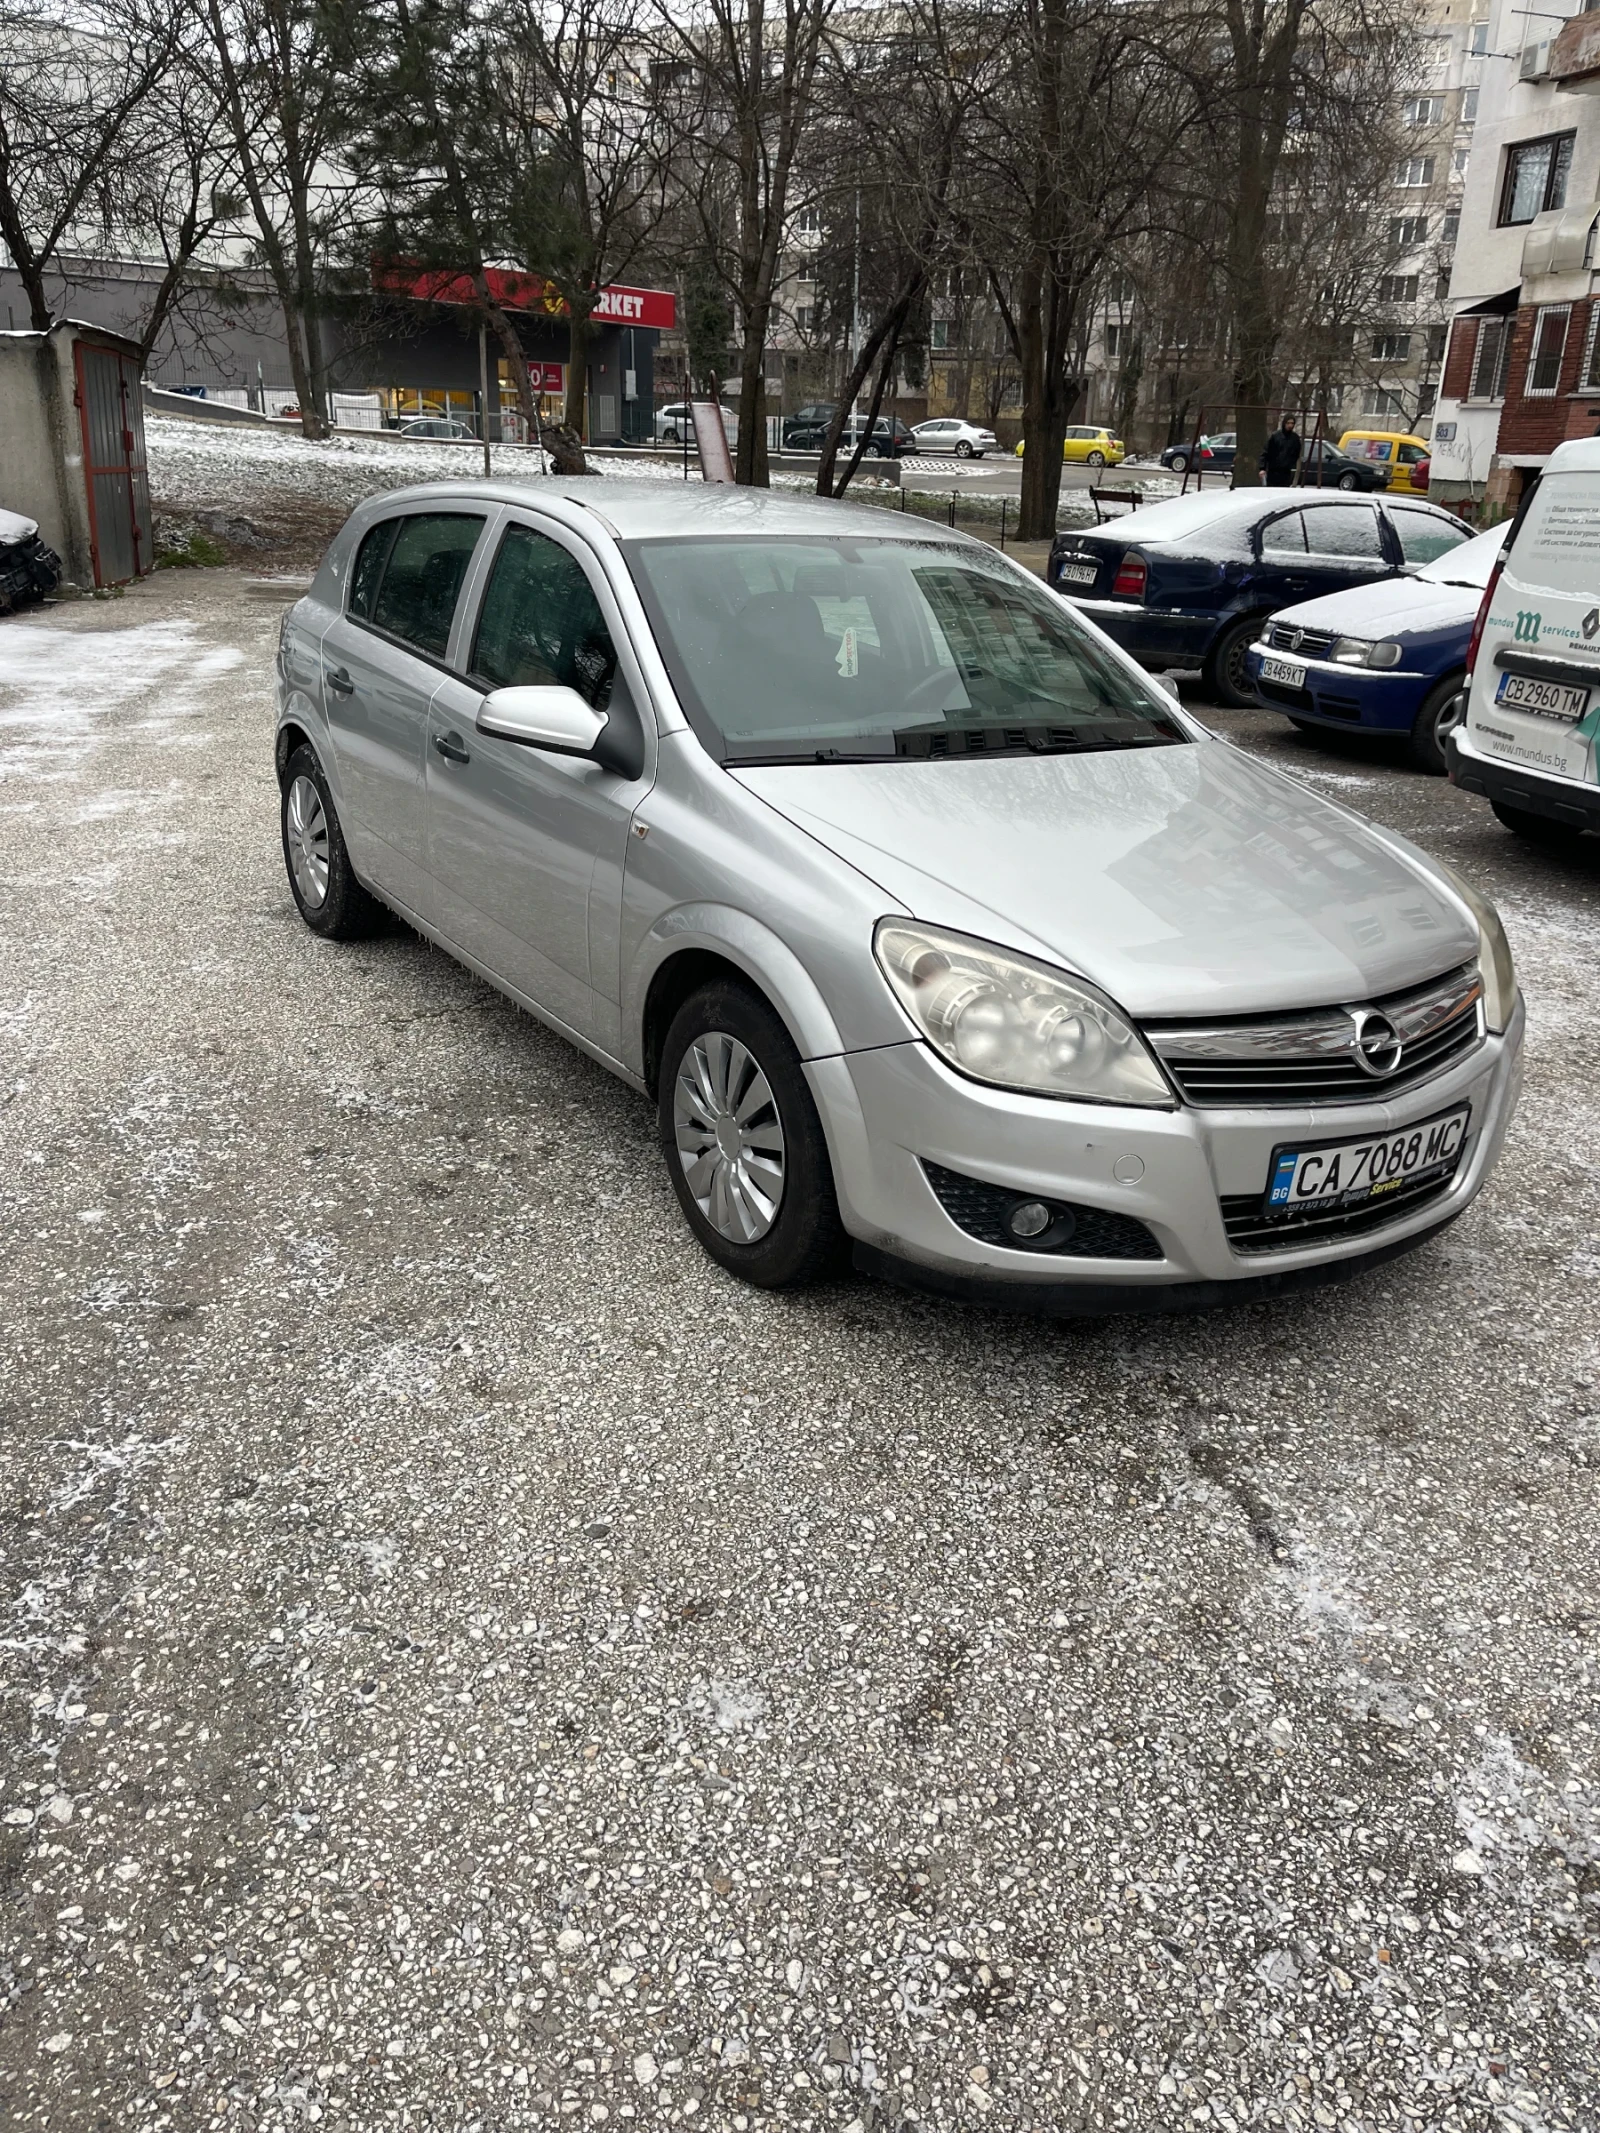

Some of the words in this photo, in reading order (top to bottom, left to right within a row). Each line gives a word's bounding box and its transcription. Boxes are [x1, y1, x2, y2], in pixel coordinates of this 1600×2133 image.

[593, 291, 644, 319] RKET
[1488, 616, 1515, 629] mundus
[1542, 624, 1581, 639] services
[1568, 641, 1600, 653] RENAULT
[1506, 679, 1525, 701] CB
[1524, 683, 1560, 709] 2960
[1562, 690, 1583, 714] TM
[1492, 740, 1568, 772] www.mundus.bg
[1296, 1153, 1341, 1197] CA
[1346, 1132, 1423, 1188] 7088
[1422, 1118, 1461, 1166] MC
[1272, 1187, 1288, 1200] BG
[1370, 1178, 1403, 1195] Service
